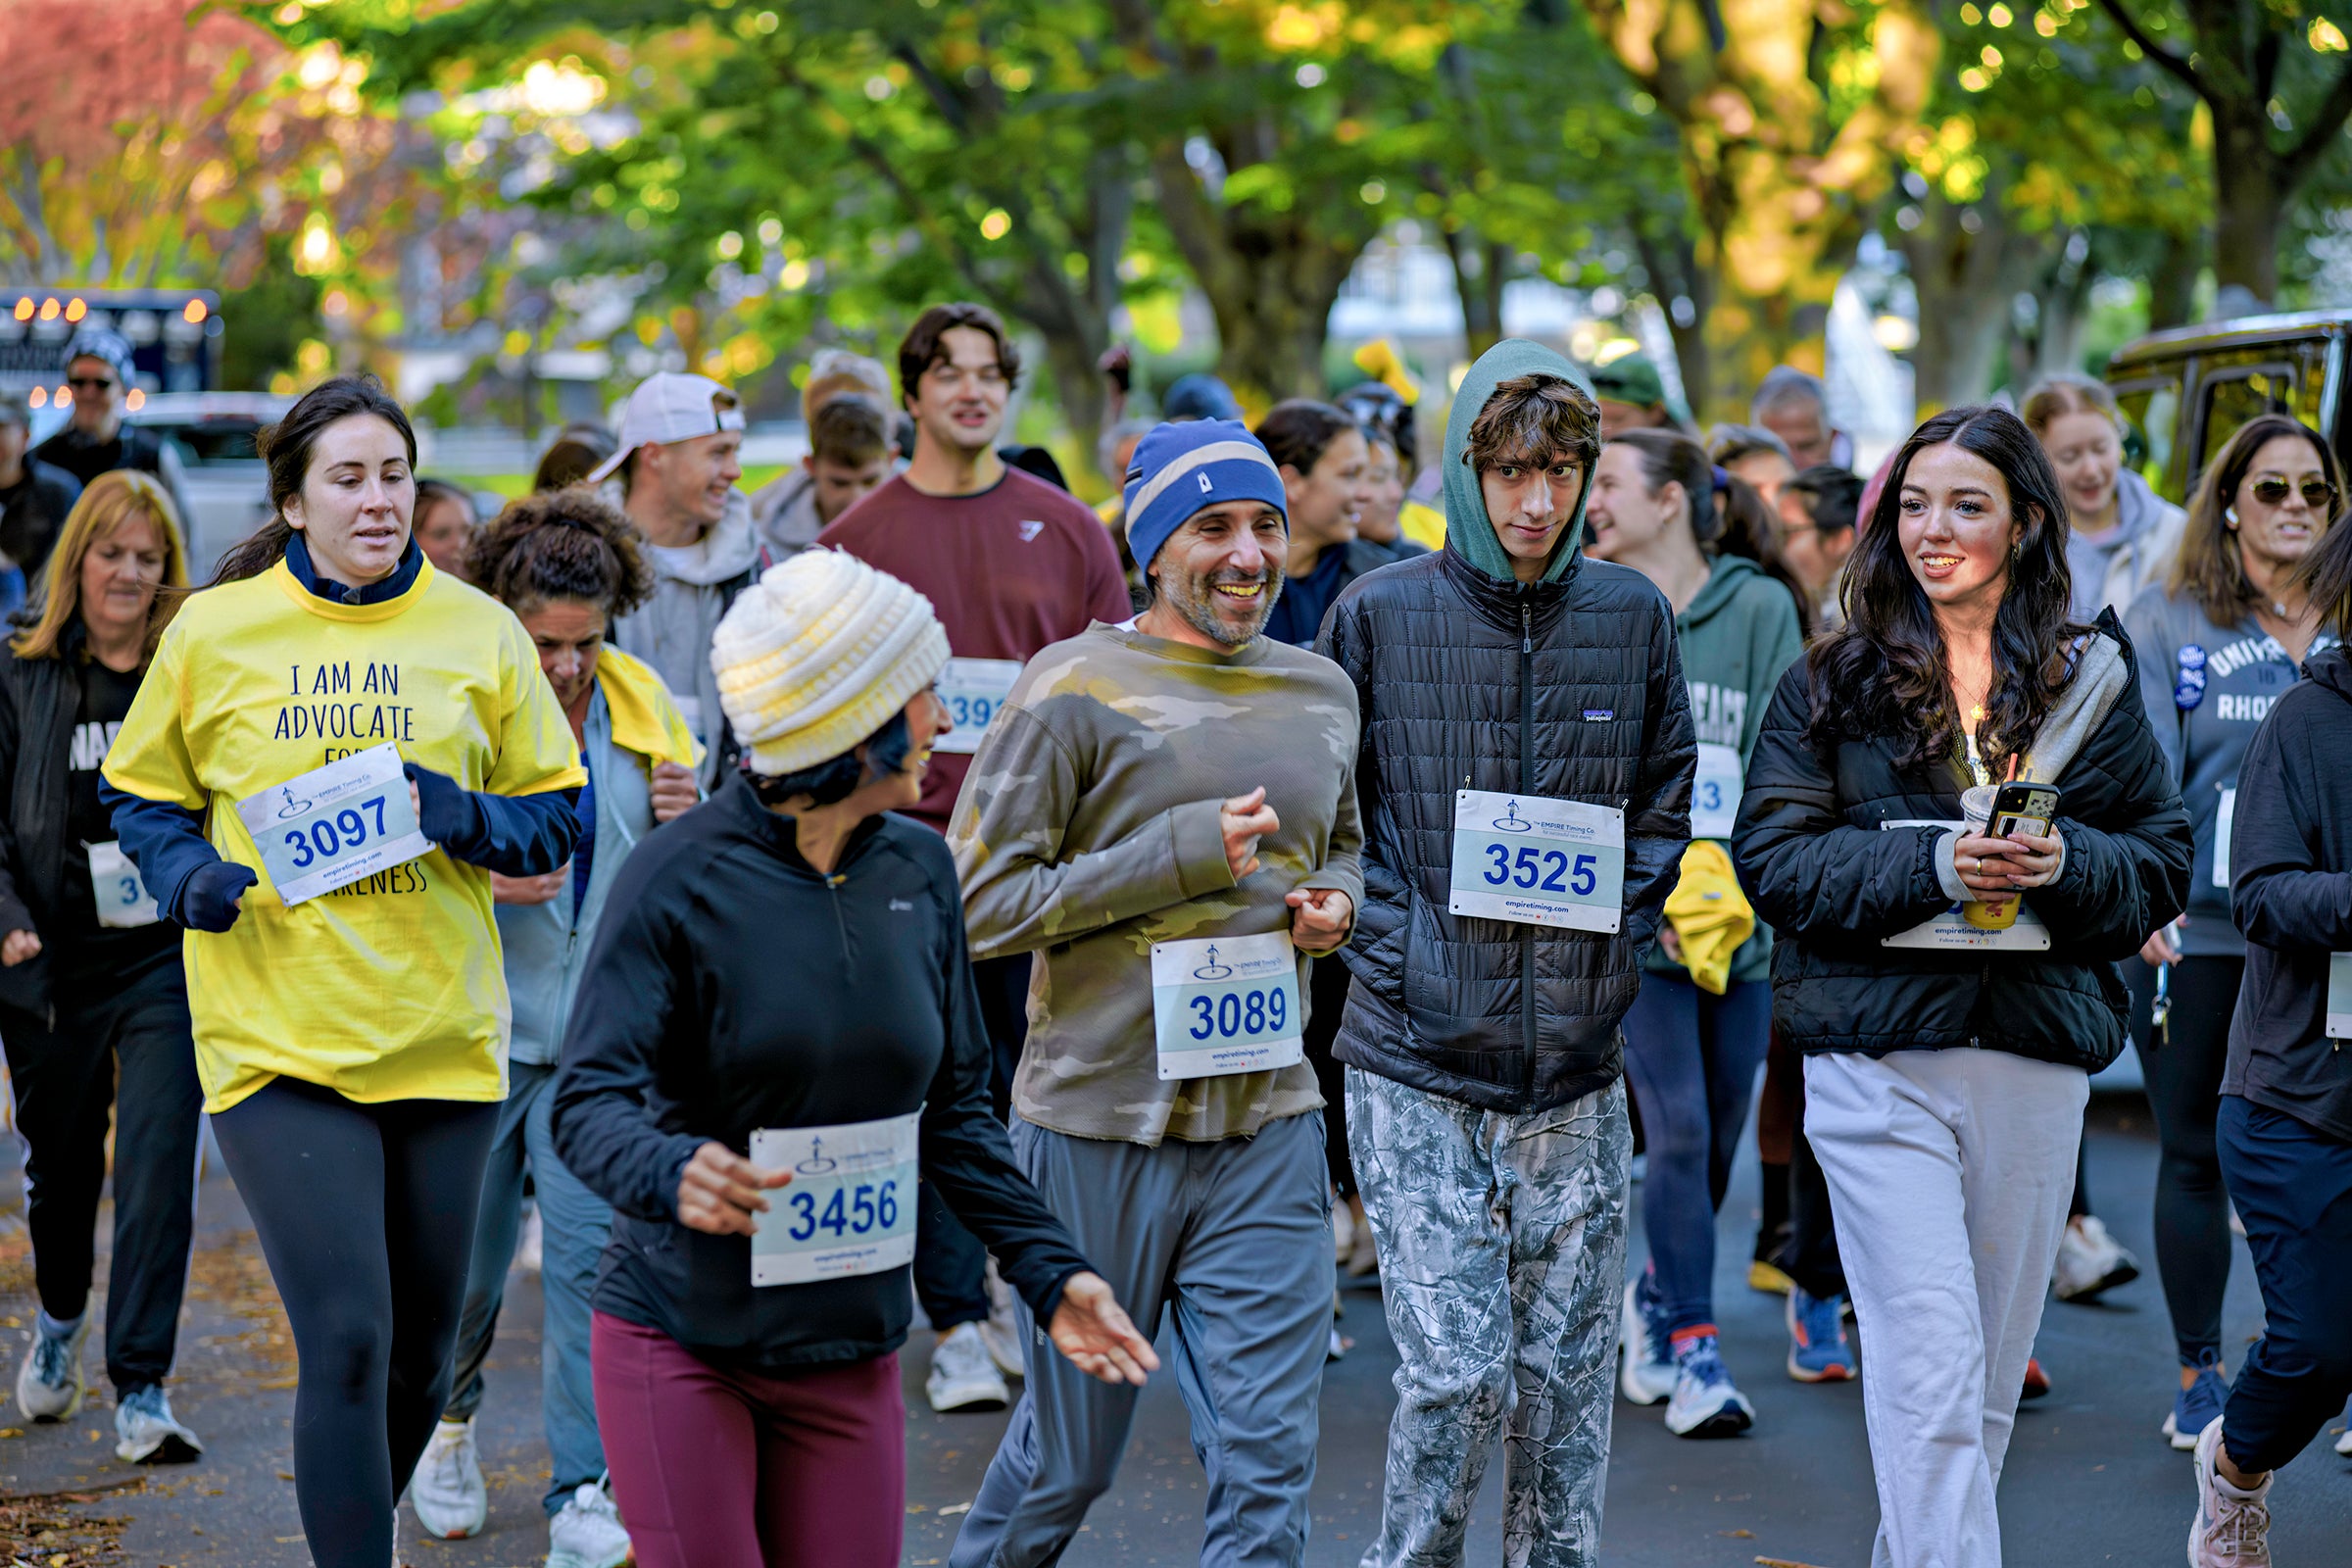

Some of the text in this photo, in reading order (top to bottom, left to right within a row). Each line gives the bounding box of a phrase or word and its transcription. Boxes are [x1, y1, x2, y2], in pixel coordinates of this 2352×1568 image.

[290, 661, 398, 696] I AM AN
[274, 703, 415, 742] ADVOCATE
[938, 693, 1007, 727] 39
[2217, 693, 2278, 721] RHO
[285, 796, 386, 867] 3097
[1541, 821, 1565, 830] EMPIRE
[1566, 824, 1586, 834] Timing
[322, 851, 382, 879] empiretiming.com
[1483, 844, 1597, 896] 3525
[1505, 901, 1569, 913] empiretiming.com
[1935, 926, 2002, 936] empiretiming.com
[1189, 987, 1287, 1041] 3089
[789, 1181, 898, 1241] 3456
